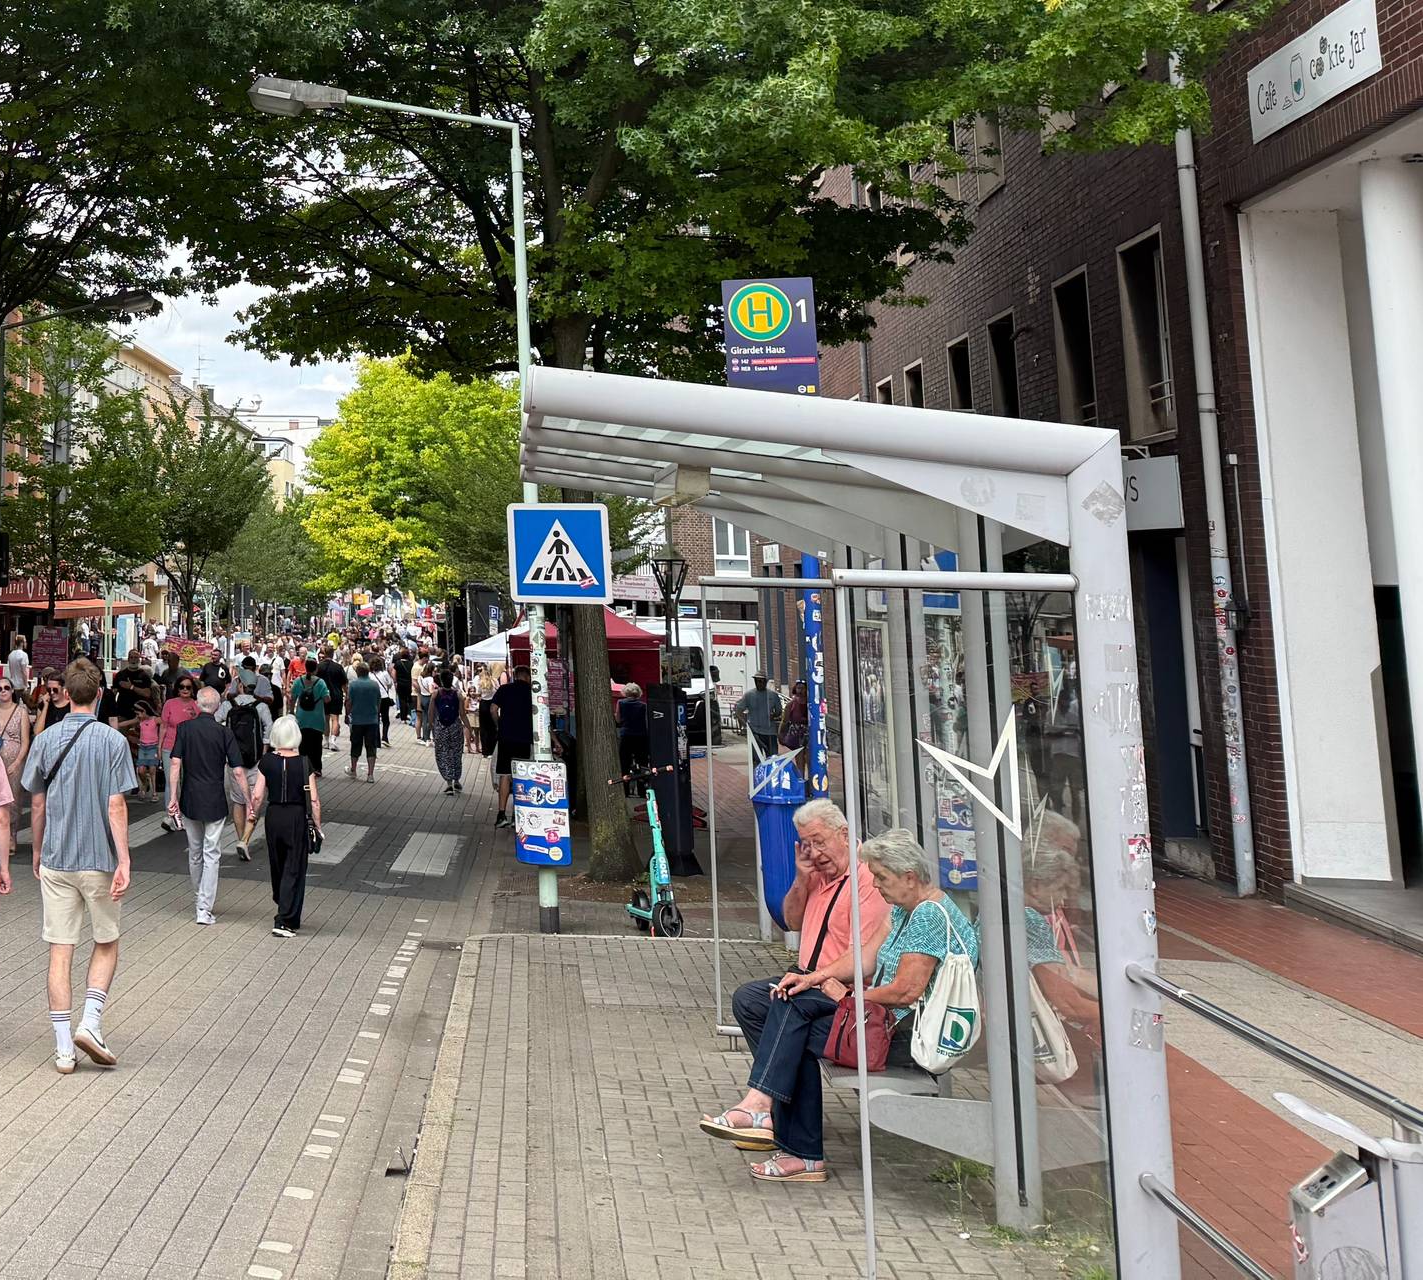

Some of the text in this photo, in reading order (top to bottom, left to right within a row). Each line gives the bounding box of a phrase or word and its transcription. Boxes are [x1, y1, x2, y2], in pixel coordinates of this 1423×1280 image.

[1258, 80, 1278, 115] Café
[746, 296, 773, 328] H
[795, 299, 807, 323] 1
[730, 345, 786, 355] Girardet Haus
